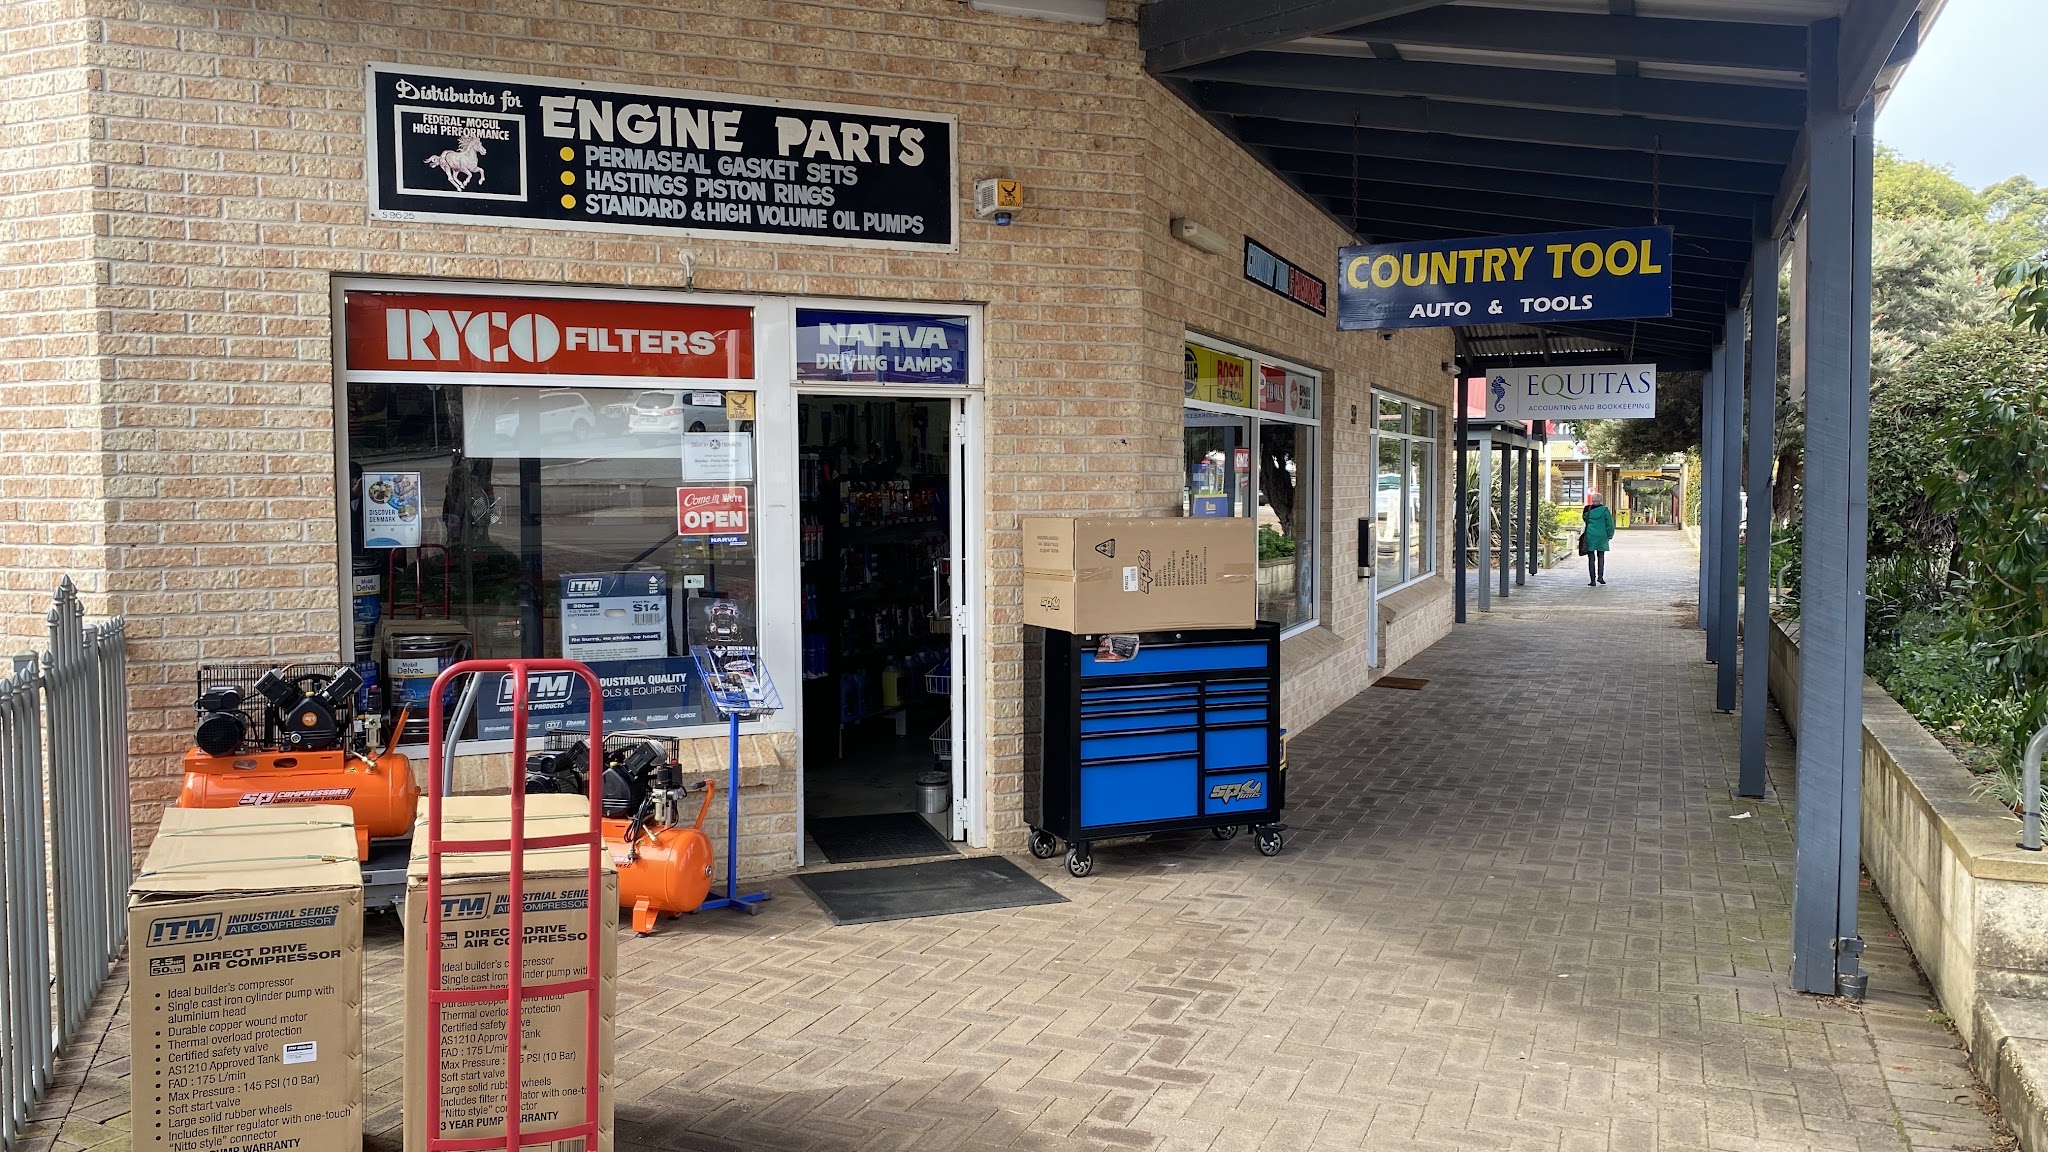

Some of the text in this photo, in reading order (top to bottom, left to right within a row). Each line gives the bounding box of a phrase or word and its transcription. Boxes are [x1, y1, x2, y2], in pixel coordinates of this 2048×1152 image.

[396, 79, 523, 112] Distributors for
[412, 123, 510, 141] HIGH PERFORMANCE
[423, 114, 500, 130] FEDERAL-MOGUL
[539, 96, 925, 167] ENGINE PARTS
[585, 145, 858, 185] PERMASEAL GASKET SETS
[586, 170, 835, 206] HASTINGS PISTON RINGS
[585, 194, 687, 220] STANDARD
[757, 205, 828, 229] VOLUME
[833, 210, 860, 231] OIL
[864, 212, 925, 235] PUMPS
[1347, 239, 1662, 289] COUNTRY TOOL
[1409, 294, 1593, 319] AUTO & TOOLS
[386, 308, 716, 363] RYCO FILTERS
[819, 322, 949, 350] NARVA
[815, 353, 953, 373] DRIVING LAMPS
[1217, 359, 1244, 390] BOSCH
[1216, 388, 1244, 402] ELECTRICAL
[1528, 371, 1651, 400] EQUITAS
[1528, 404, 1577, 412] ACCOUNTING
[683, 492, 743, 507] Come in We're
[684, 511, 743, 529] OPEN
[570, 580, 600, 592] ITM
[633, 603, 660, 612] S14
[600, 673, 687, 687] DUSTRIAL QUALITY
[602, 684, 688, 698] OLS & EQUIPMENT
[534, 702, 565, 710] PRODUCTS
[239, 788, 350, 805] SP COMPRESSORS
[1210, 784, 1242, 803] SP
[228, 905, 340, 925] INDUSTRIAL SERIES
[153, 918, 216, 943] ITM
[229, 918, 331, 934] AIR COMPRESSOR
[192, 949, 341, 973] AIR COMPRESSOR
[193, 943, 308, 963] DIRECT DRIVE
[168, 978, 294, 999] Ideal builder's compressor
[168, 985, 335, 1012] Single cast iron cylinder pump with
[168, 1006, 246, 1024] aluminium head
[168, 1012, 308, 1037] Durable copper wound motor
[441, 1020, 506, 1033] Certified safety
[168, 1026, 302, 1050] Thermal overload protection
[168, 1043, 269, 1063] Certified safety valve
[168, 1054, 281, 1076] AS1210 Approved Tank
[441, 1069, 505, 1083] Soft start valve
[168, 1074, 320, 1102] Max Pressure 145 PSI (10 Bar)
[168, 1097, 241, 1115] Soft start valve
[168, 1103, 293, 1128] Large solid rubber wheels
[168, 1108, 351, 1141] Includes filter regulator with one-touch
[242, 1138, 301, 1152] WARRANTY
